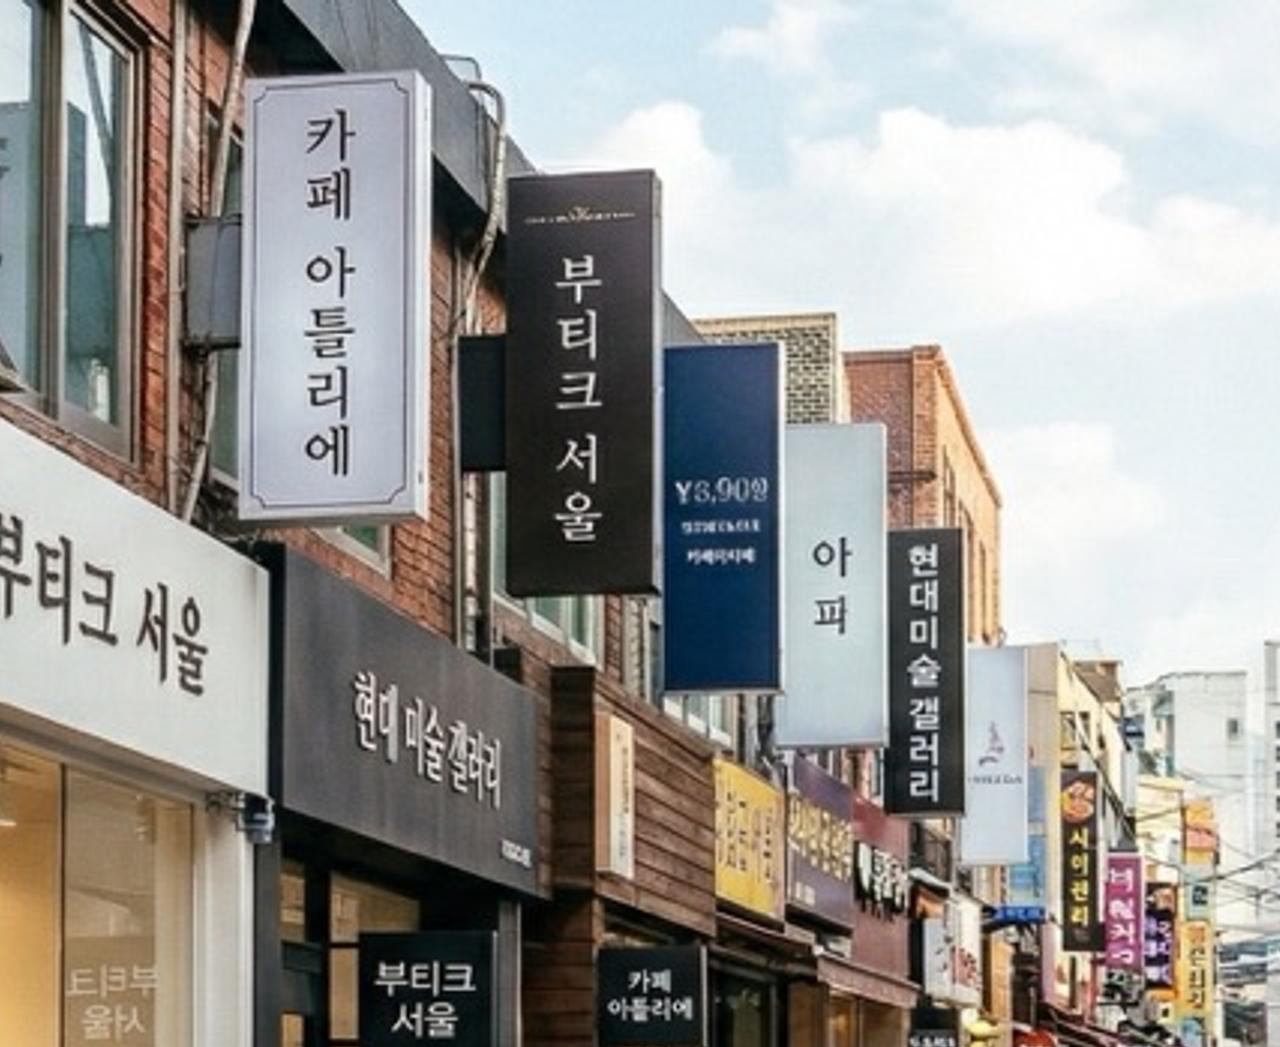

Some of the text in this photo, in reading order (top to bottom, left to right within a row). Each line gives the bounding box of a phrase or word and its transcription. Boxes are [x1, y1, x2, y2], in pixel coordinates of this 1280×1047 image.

[303, 109, 357, 477] 카페 아틀리에
[554, 254, 602, 410] 부티크
[554, 434, 602, 542] 서울
[136, 582, 208, 696] 서울
[907, 543, 941, 802] 현대미술갤러리
[374, 961, 476, 997] 부티크
[391, 1001, 458, 1038] 서울
[627, 969, 671, 994] 카페
